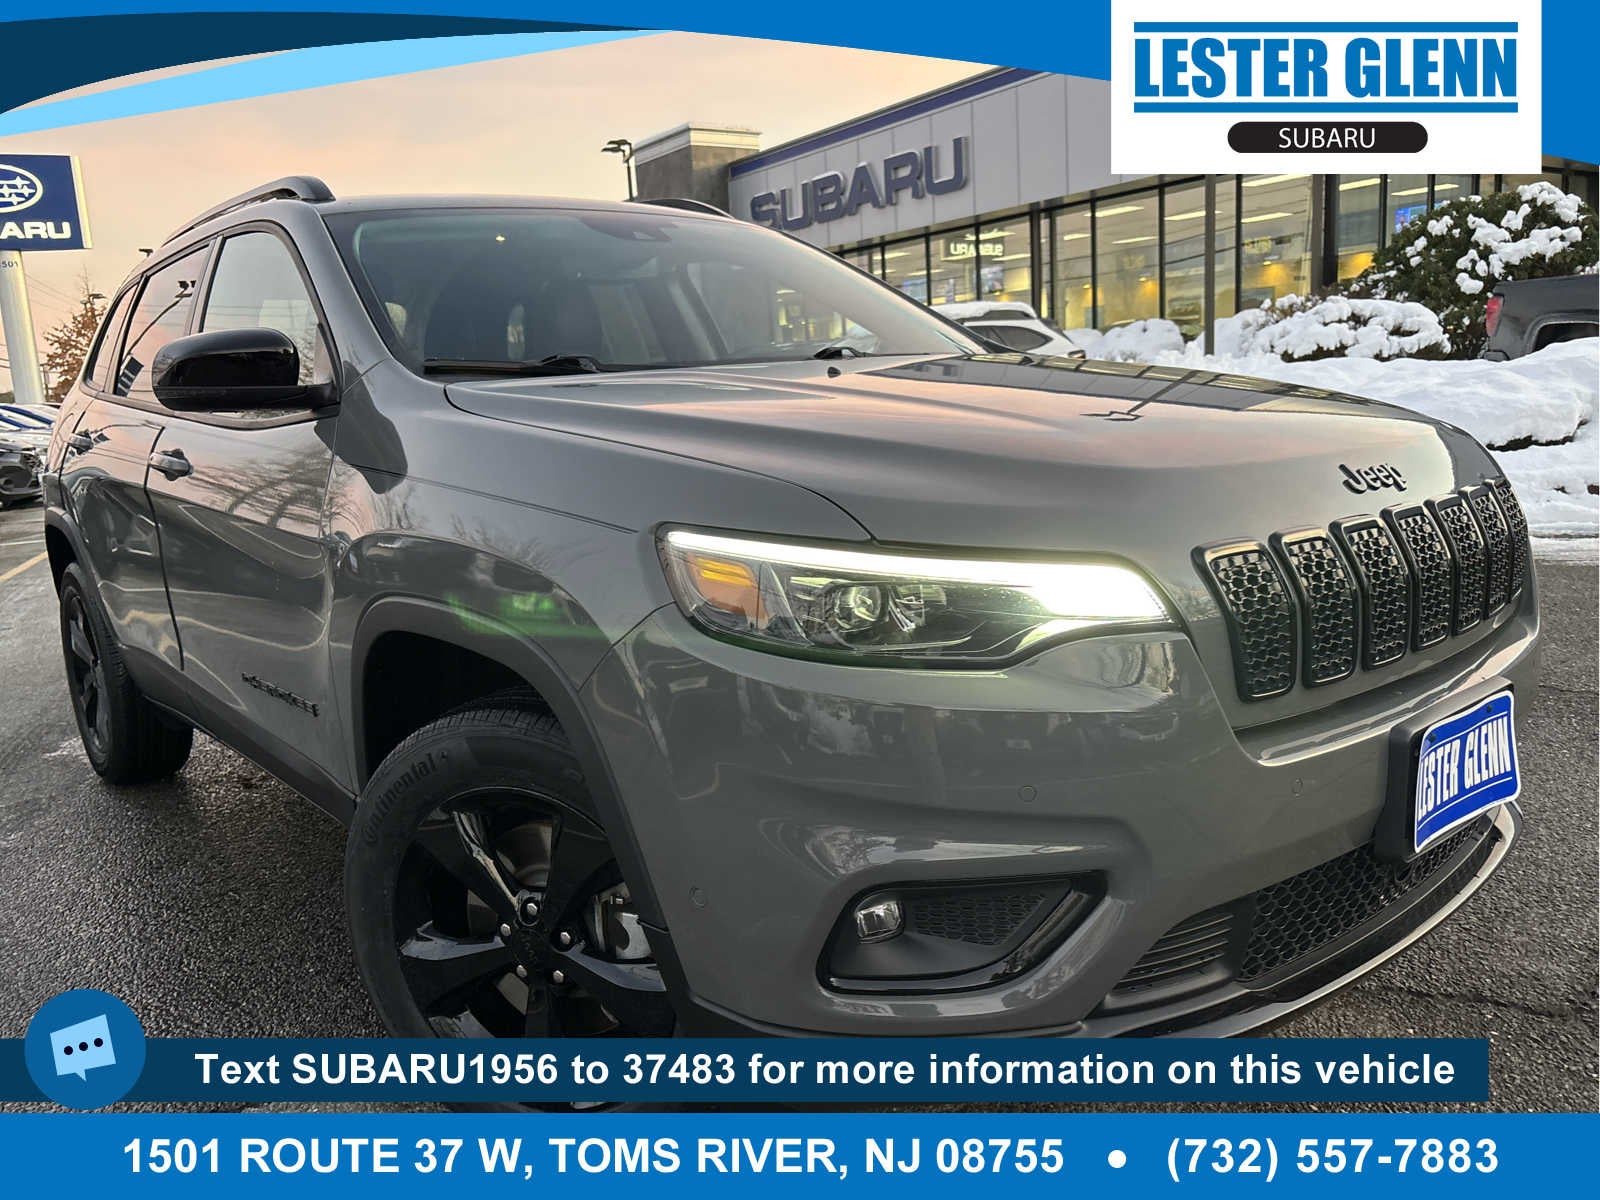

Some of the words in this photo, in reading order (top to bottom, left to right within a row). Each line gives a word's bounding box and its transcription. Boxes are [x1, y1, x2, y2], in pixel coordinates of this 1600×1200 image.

[751, 136, 967, 231] SUBARU
[1338, 463, 1407, 494] Jeep
[1417, 739, 1461, 822] LESTER
[1464, 716, 1511, 789] GLENN
